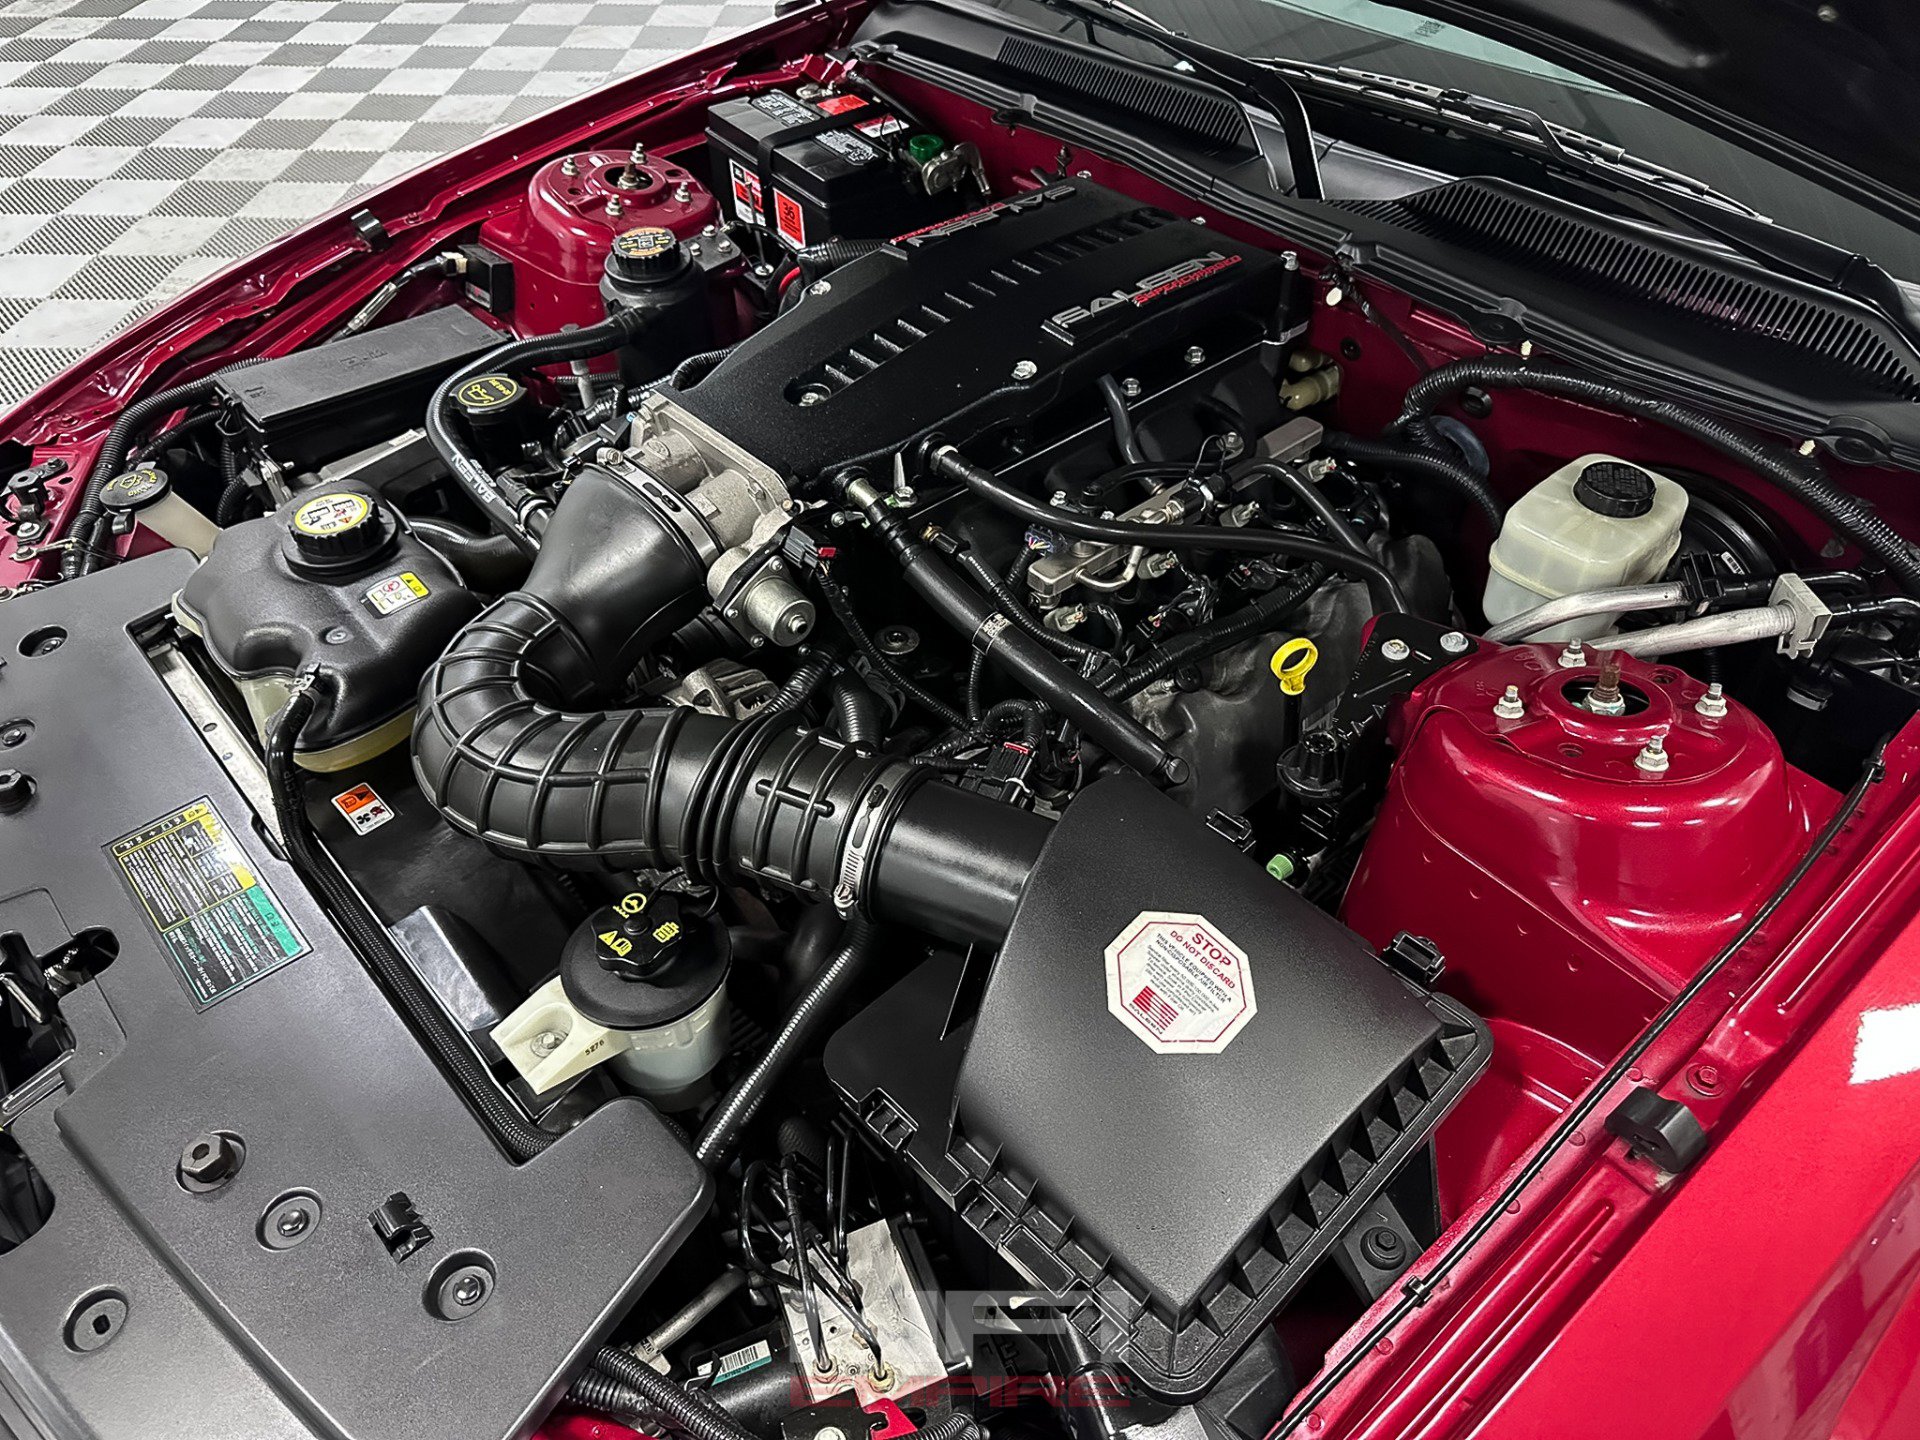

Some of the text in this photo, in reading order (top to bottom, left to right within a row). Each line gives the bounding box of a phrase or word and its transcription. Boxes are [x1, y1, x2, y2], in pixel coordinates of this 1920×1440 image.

[1052, 251, 1226, 329] SALEEN
[1133, 254, 1243, 307] SUPERCHARGED
[1156, 933, 1168, 944] THIS
[1167, 943, 1188, 962] VEHICLE
[1188, 961, 1214, 985] EQUIPPED
[1213, 984, 1228, 997] WITH
[1170, 930, 1236, 989] DO NOT DISCARD
[1192, 932, 1231, 967] STOP
